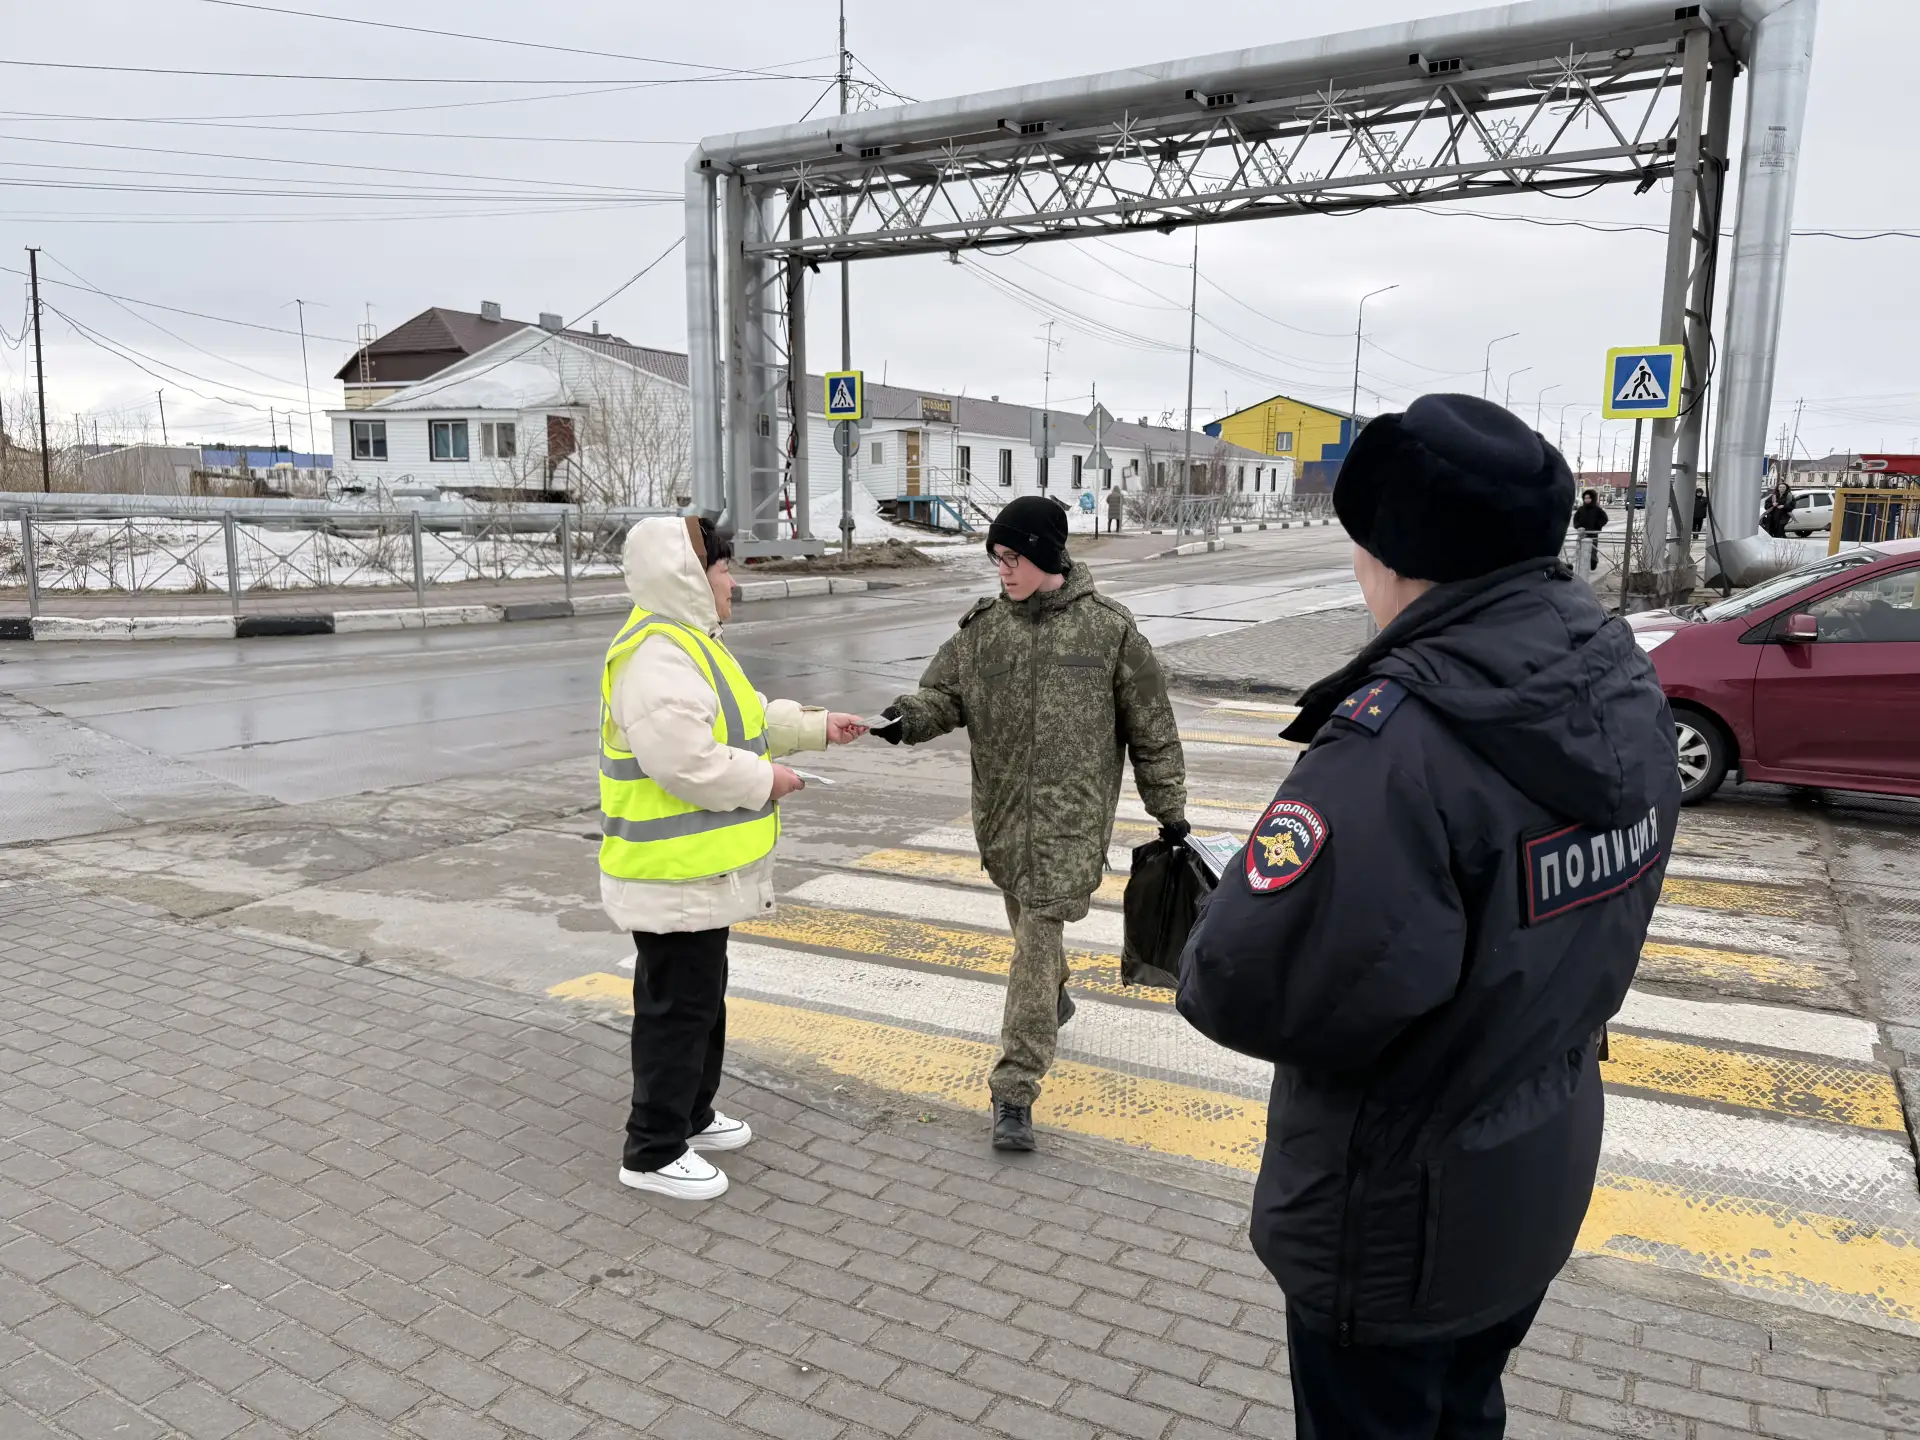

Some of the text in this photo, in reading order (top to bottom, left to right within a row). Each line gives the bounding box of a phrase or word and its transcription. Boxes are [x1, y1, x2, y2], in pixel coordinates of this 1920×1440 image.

[1270, 817, 1311, 848] РОССИЯ
[1272, 803, 1323, 840] ПОЛИЦИЯ
[1540, 806, 1658, 901] ПОЛИЦИЯ
[1247, 867, 1272, 889] МВД
